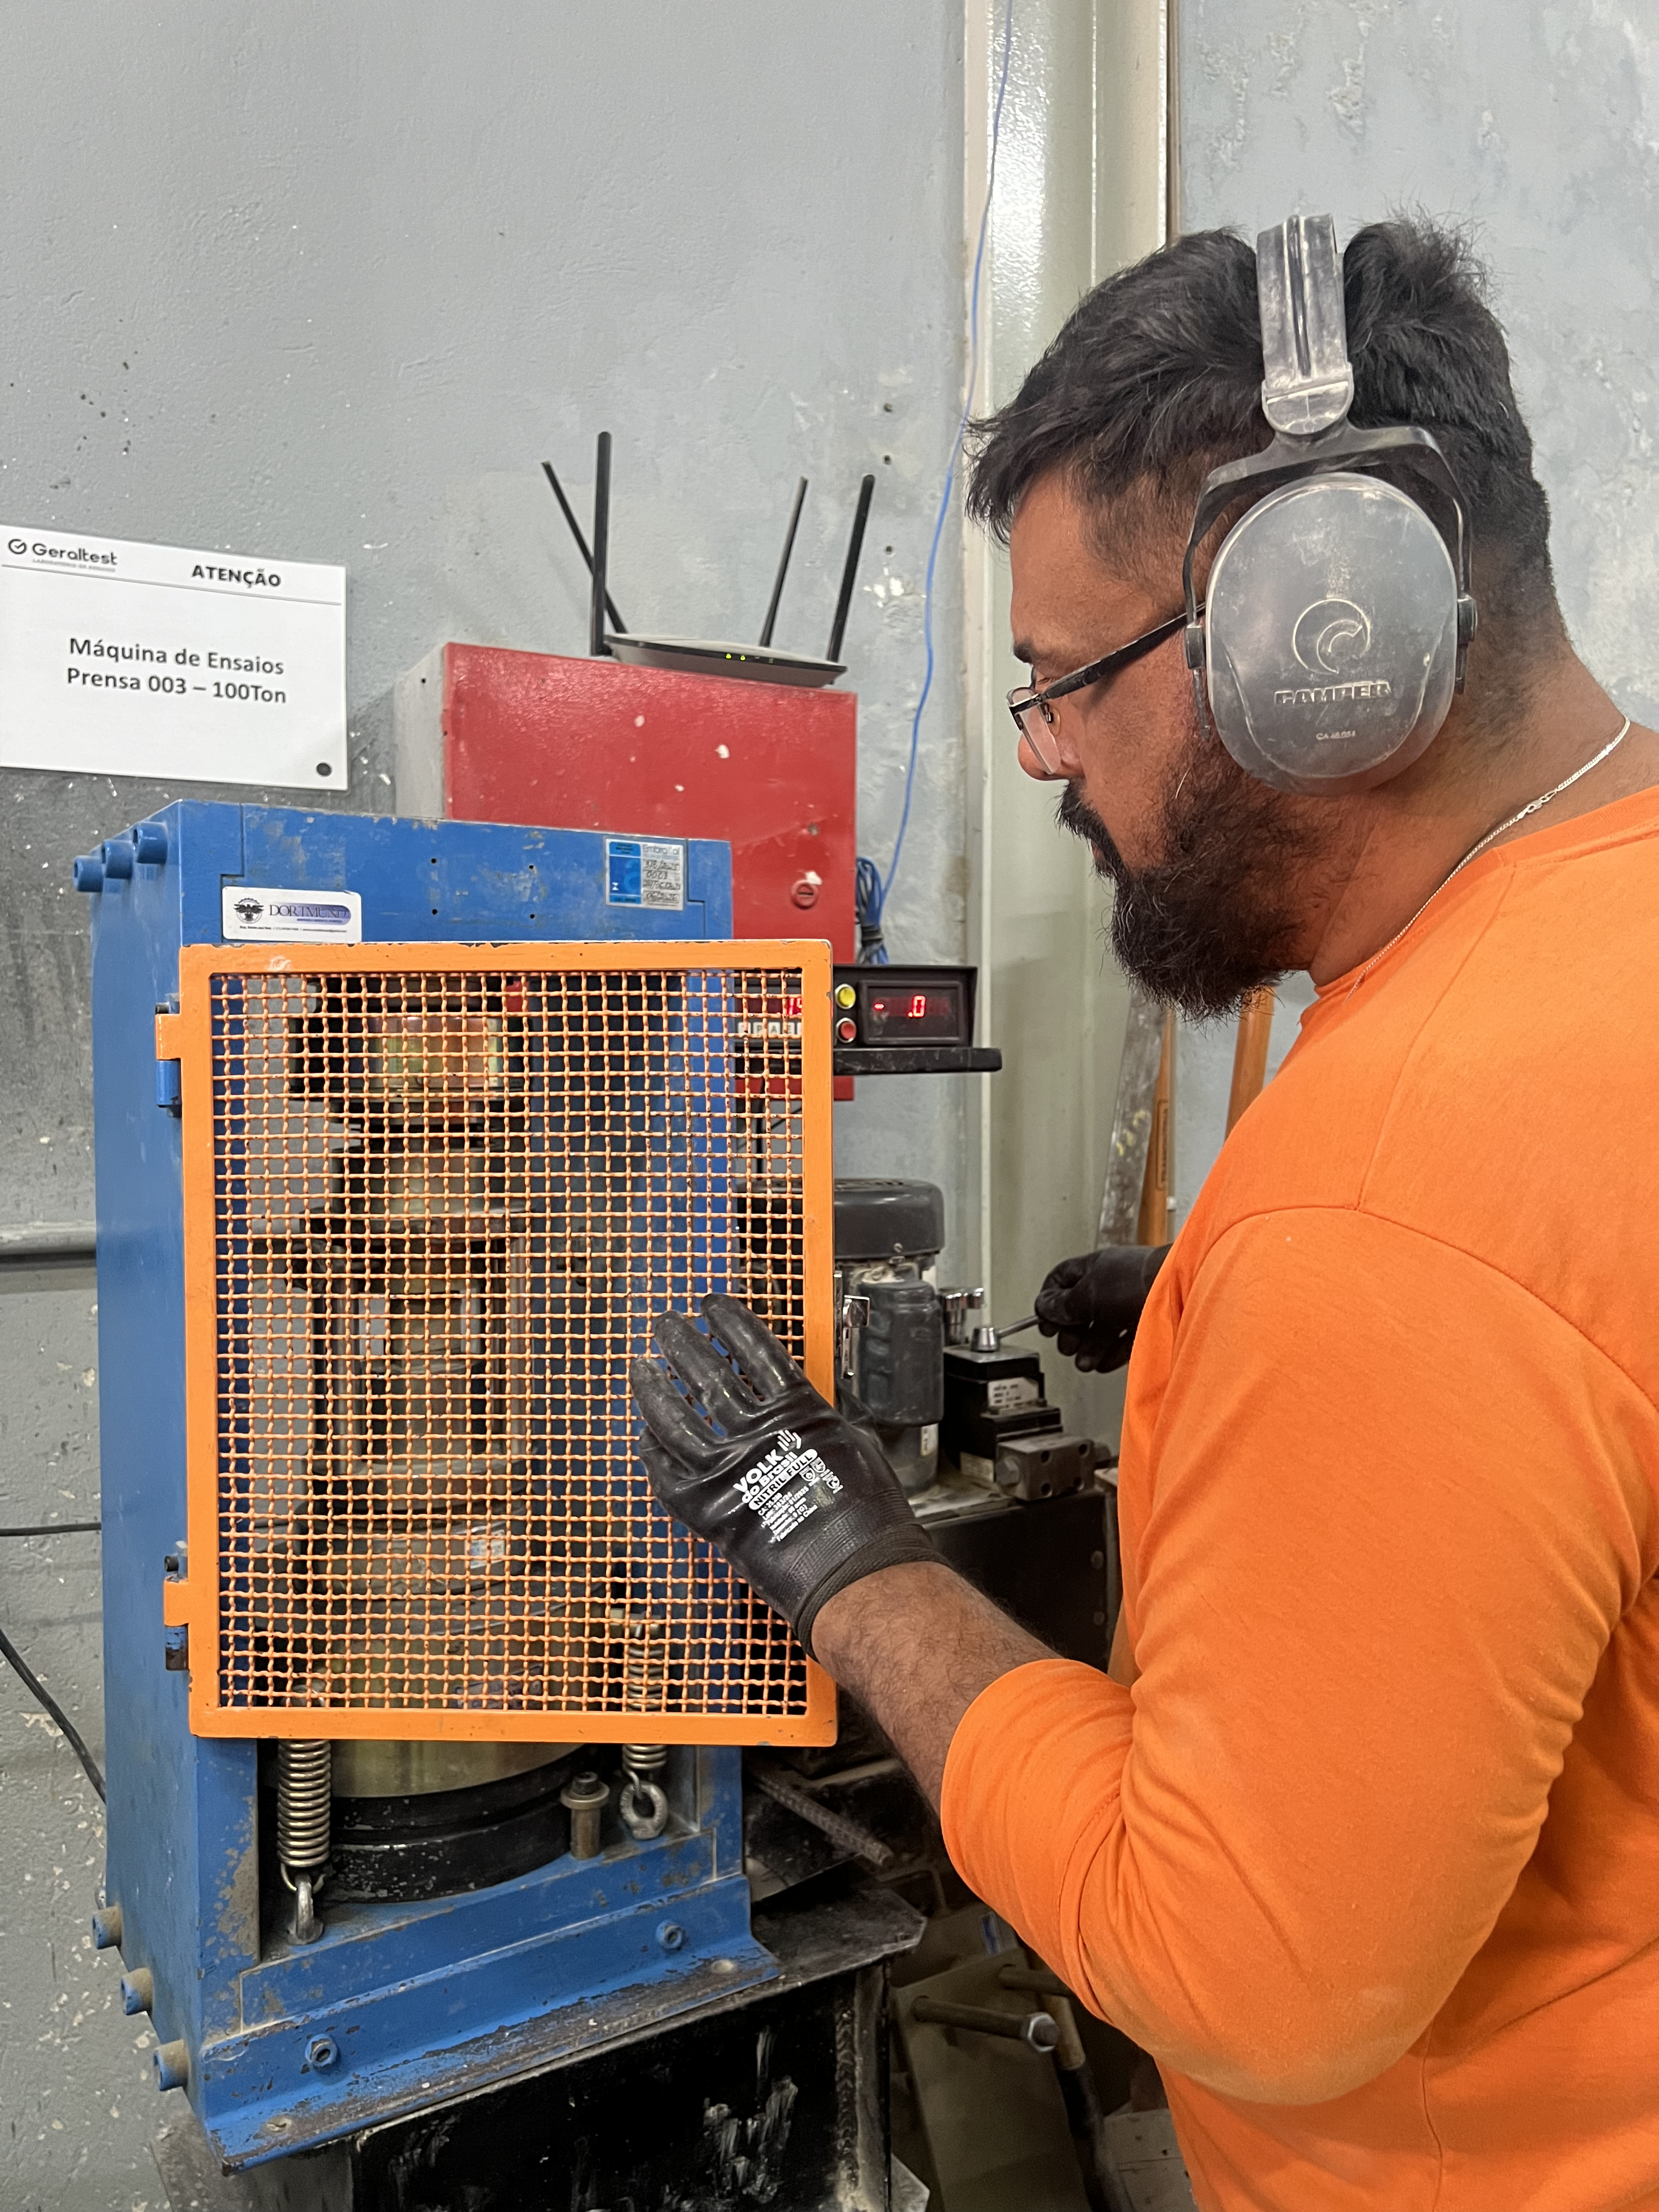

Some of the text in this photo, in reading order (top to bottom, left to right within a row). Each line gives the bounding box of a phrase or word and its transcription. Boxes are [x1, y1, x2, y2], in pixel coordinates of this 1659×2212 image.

[32, 543, 117, 566] Geraltest
[192, 565, 281, 588] ATENÇÃO
[70, 638, 284, 675] Máquina de Ensaios
[67, 668, 141, 690] Prensa
[148, 675, 187, 695] 003
[213, 682, 286, 703] 100Ton
[269, 905, 347, 918] DORTMUND
[733, 1449, 783, 1492] VOLK
[742, 1452, 797, 1503] do Brasil
[754, 1479, 786, 1505] NITRIL
[787, 1455, 812, 1476] FULL
